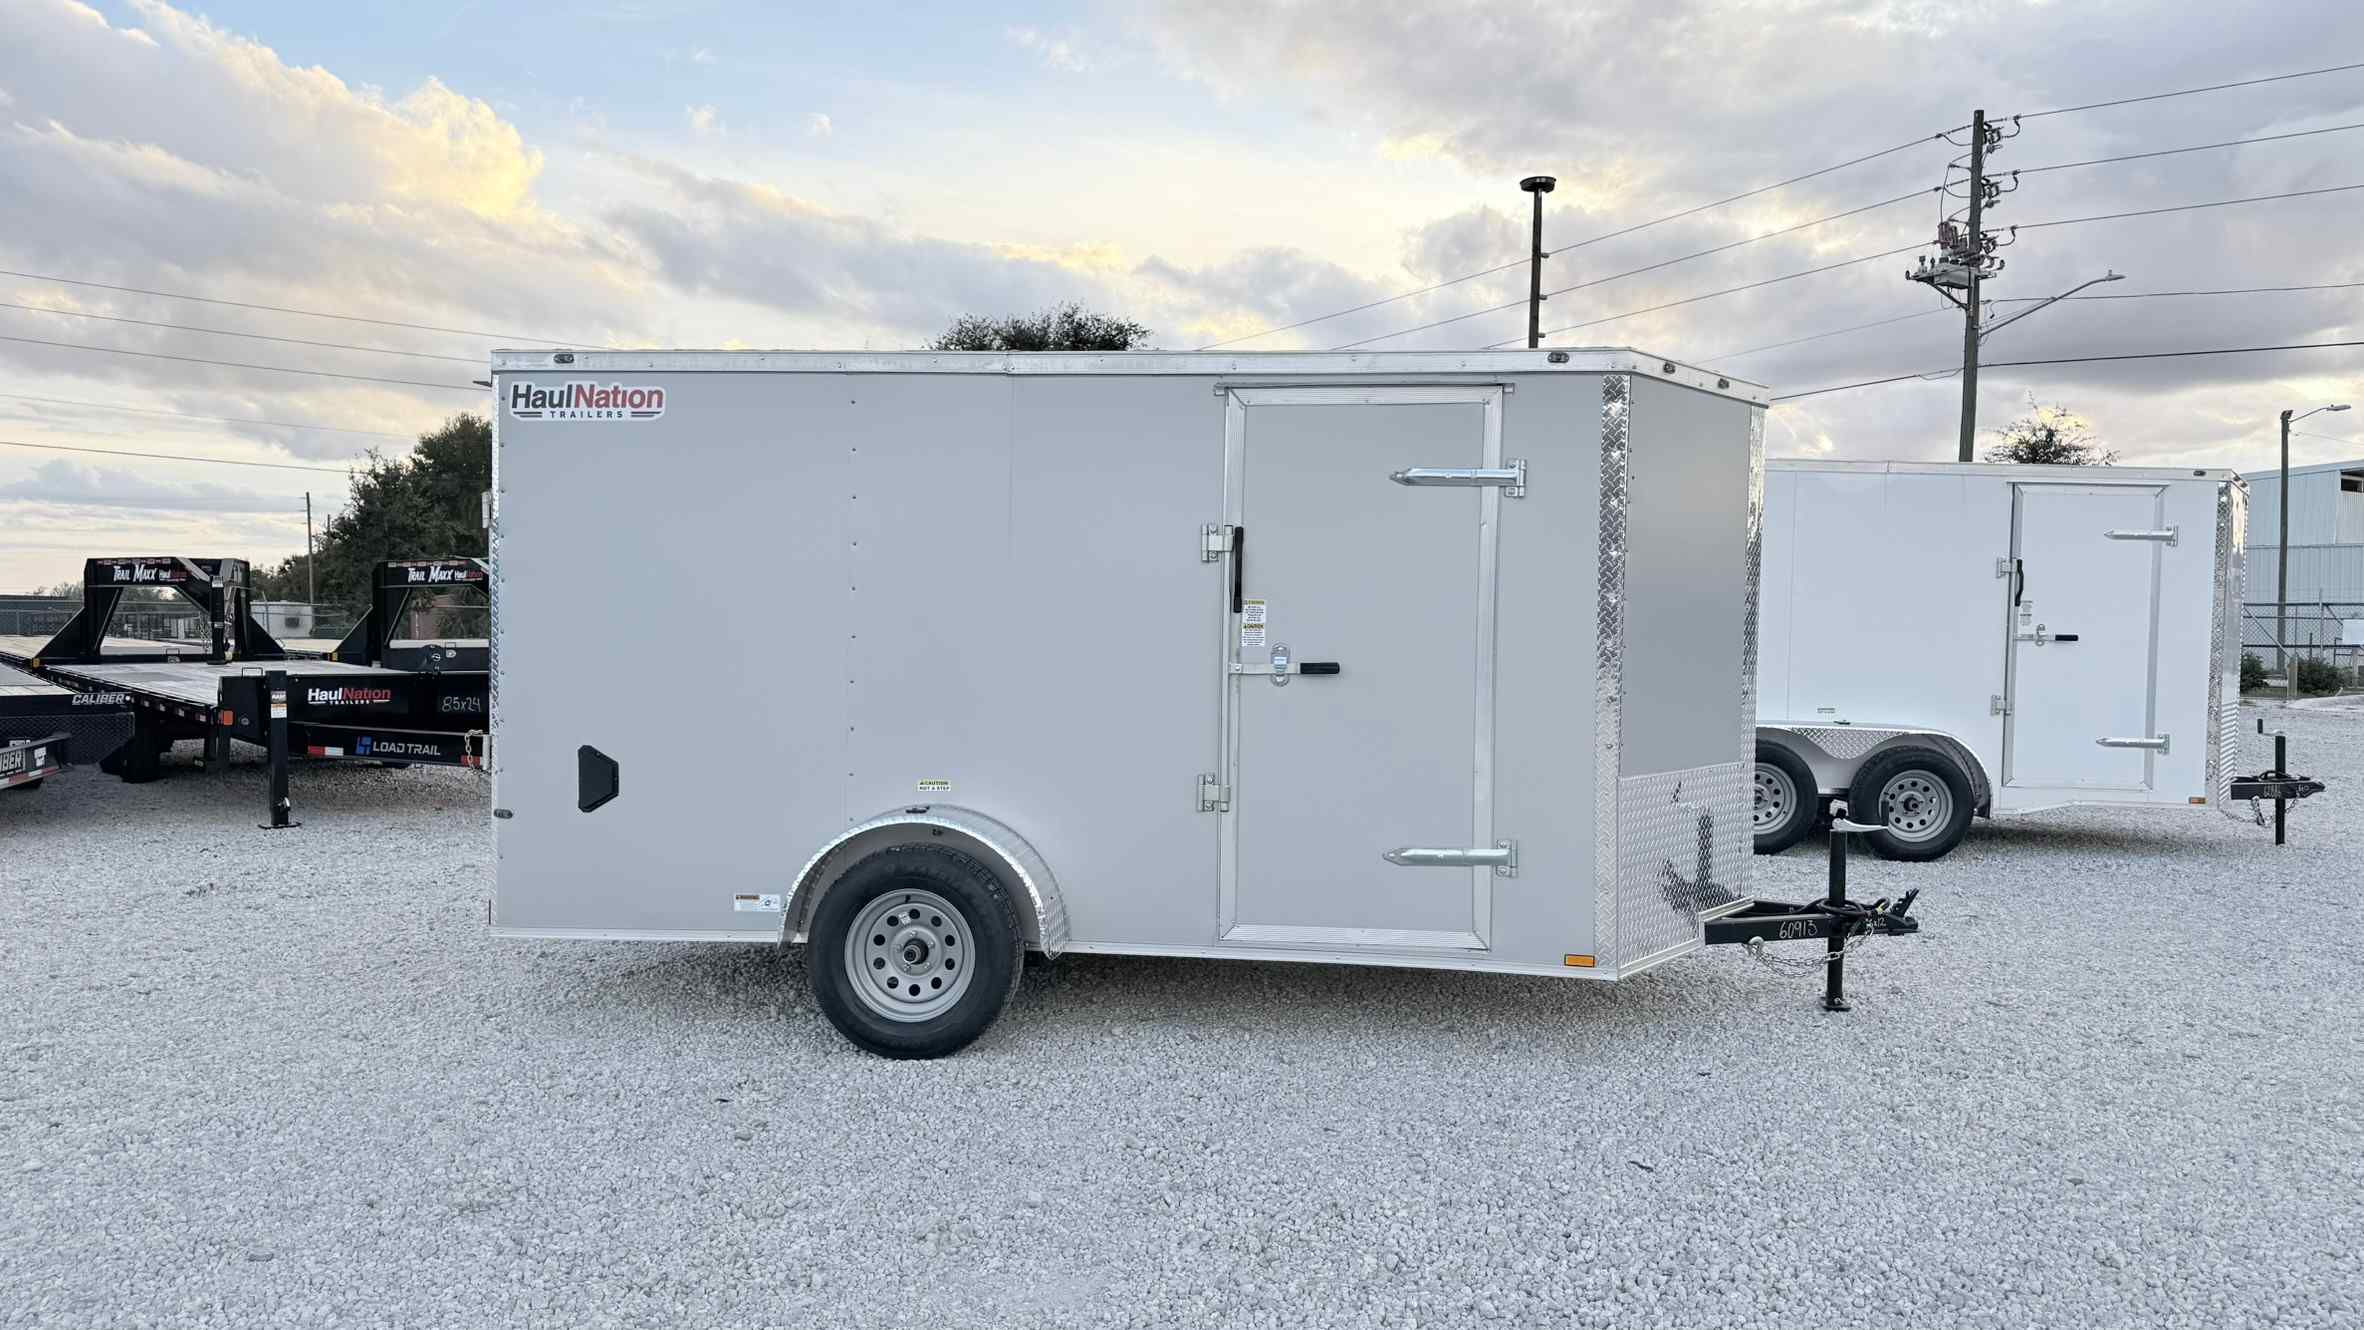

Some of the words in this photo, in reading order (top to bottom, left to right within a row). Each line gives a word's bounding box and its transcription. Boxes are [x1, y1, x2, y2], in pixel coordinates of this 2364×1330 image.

[511, 384, 664, 409] HaulNation
[550, 410, 624, 418] TRAILERS
[71, 693, 125, 706] CALIBER
[307, 687, 392, 701] HaulNation
[372, 740, 405, 753] LOAD
[406, 743, 441, 756] TRAIL
